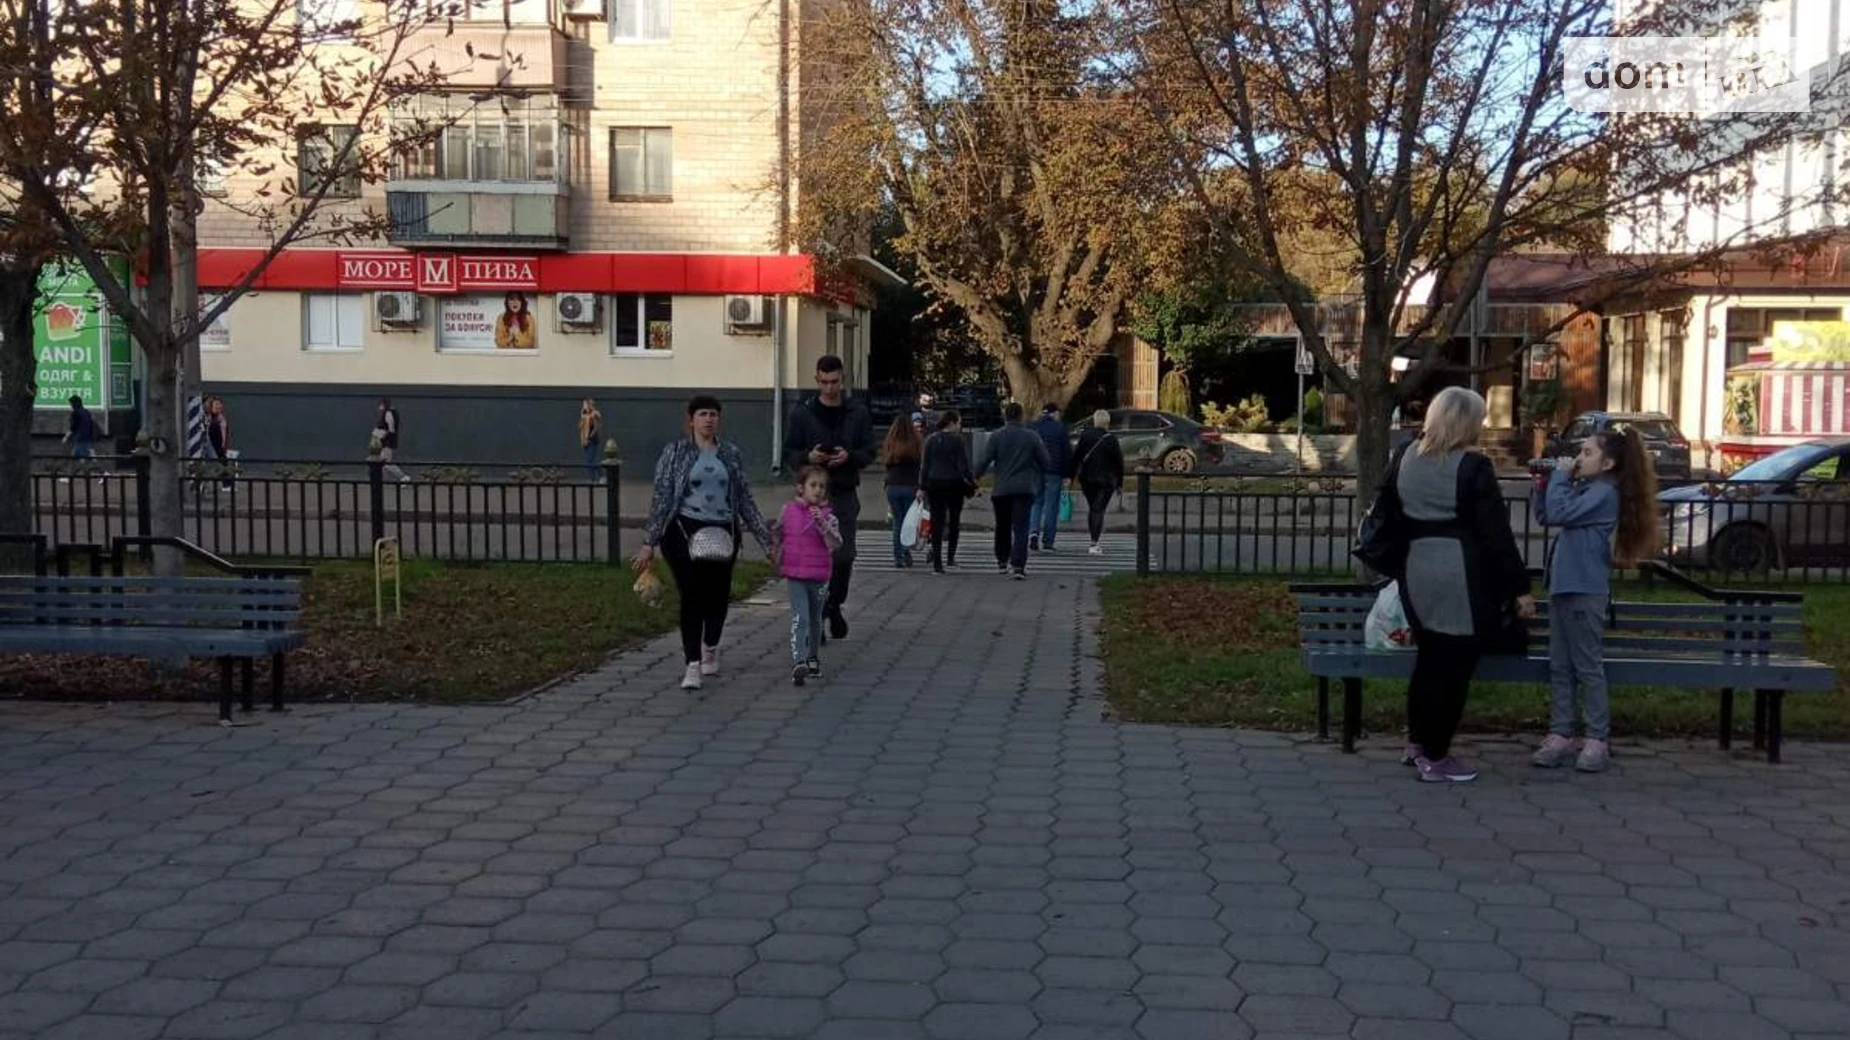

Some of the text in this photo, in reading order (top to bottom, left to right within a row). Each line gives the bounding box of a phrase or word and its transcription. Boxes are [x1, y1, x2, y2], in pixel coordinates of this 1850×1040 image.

[343, 258, 535, 284] МОРЕ М ПИВА
[40, 346, 92, 363] ANDI
[39, 369, 79, 383] ОДЯГ
[40, 387, 92, 399] ВЗУТТЯ
